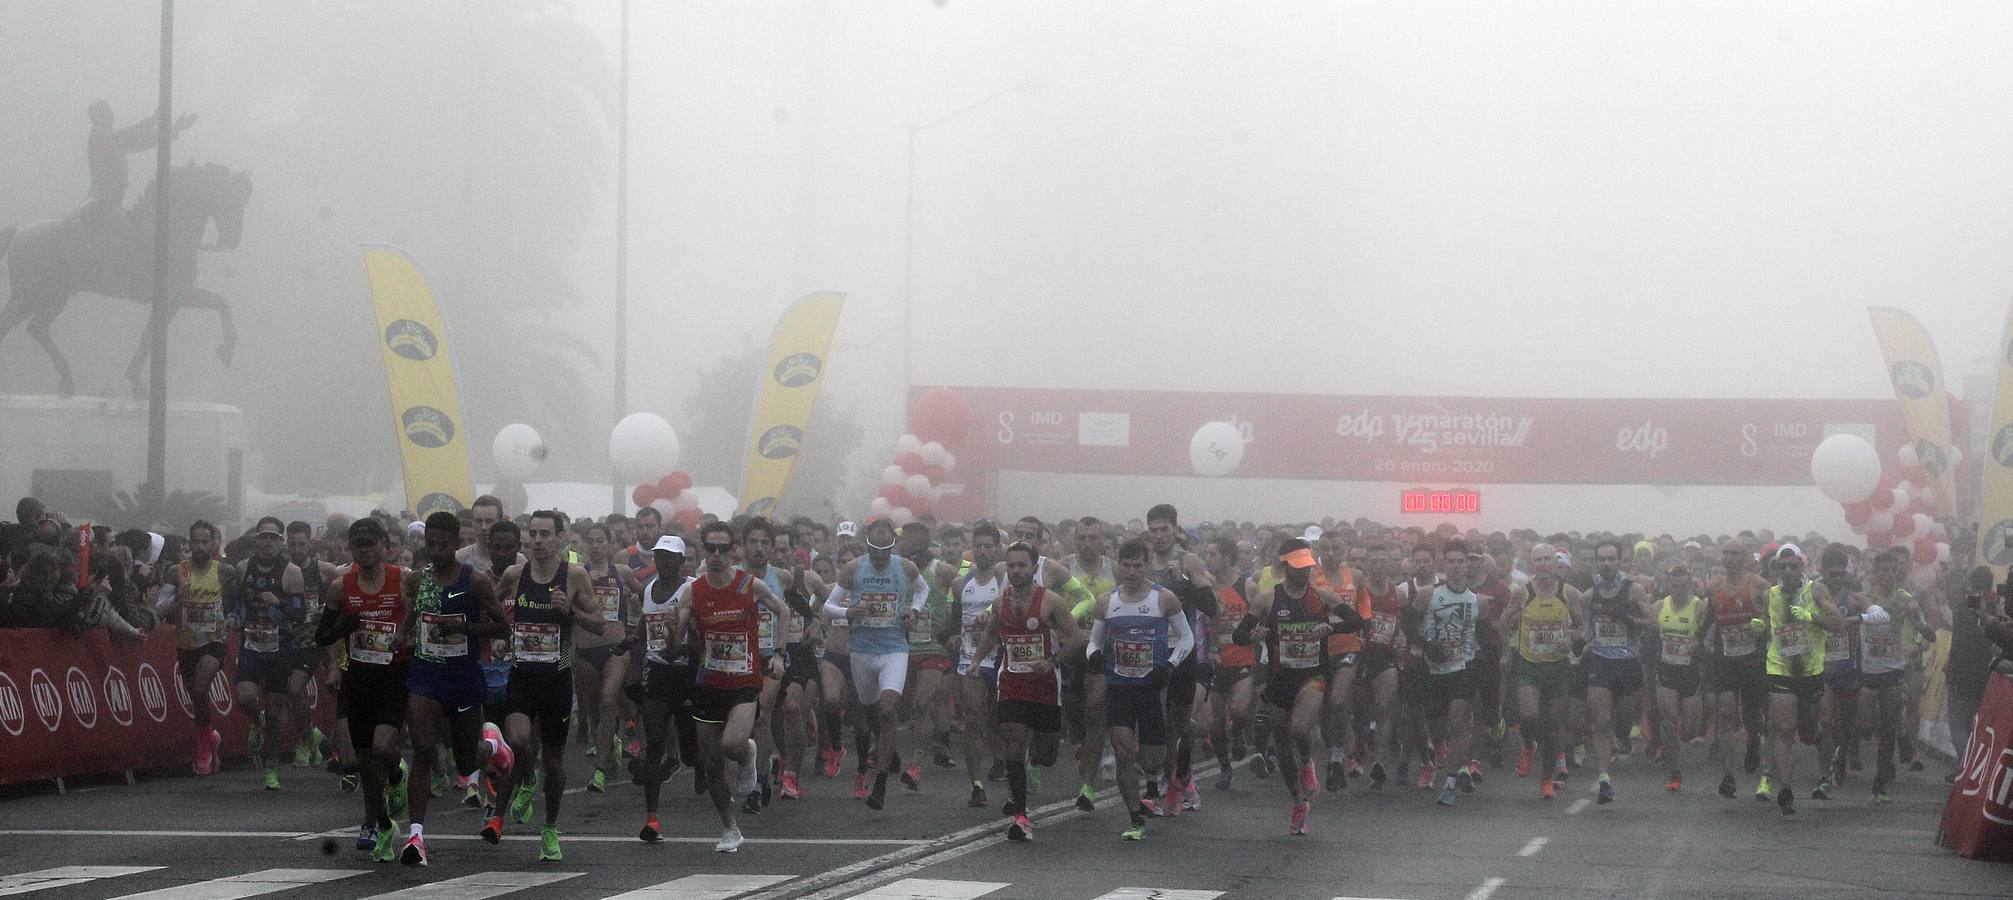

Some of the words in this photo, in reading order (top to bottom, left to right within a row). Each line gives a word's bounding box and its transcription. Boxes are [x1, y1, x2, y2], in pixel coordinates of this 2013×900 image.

[1336, 409, 1385, 443] edp
[1616, 421, 1668, 458] edp
[1401, 461, 1448, 473] enero
[1454, 460, 1495, 473] 2020
